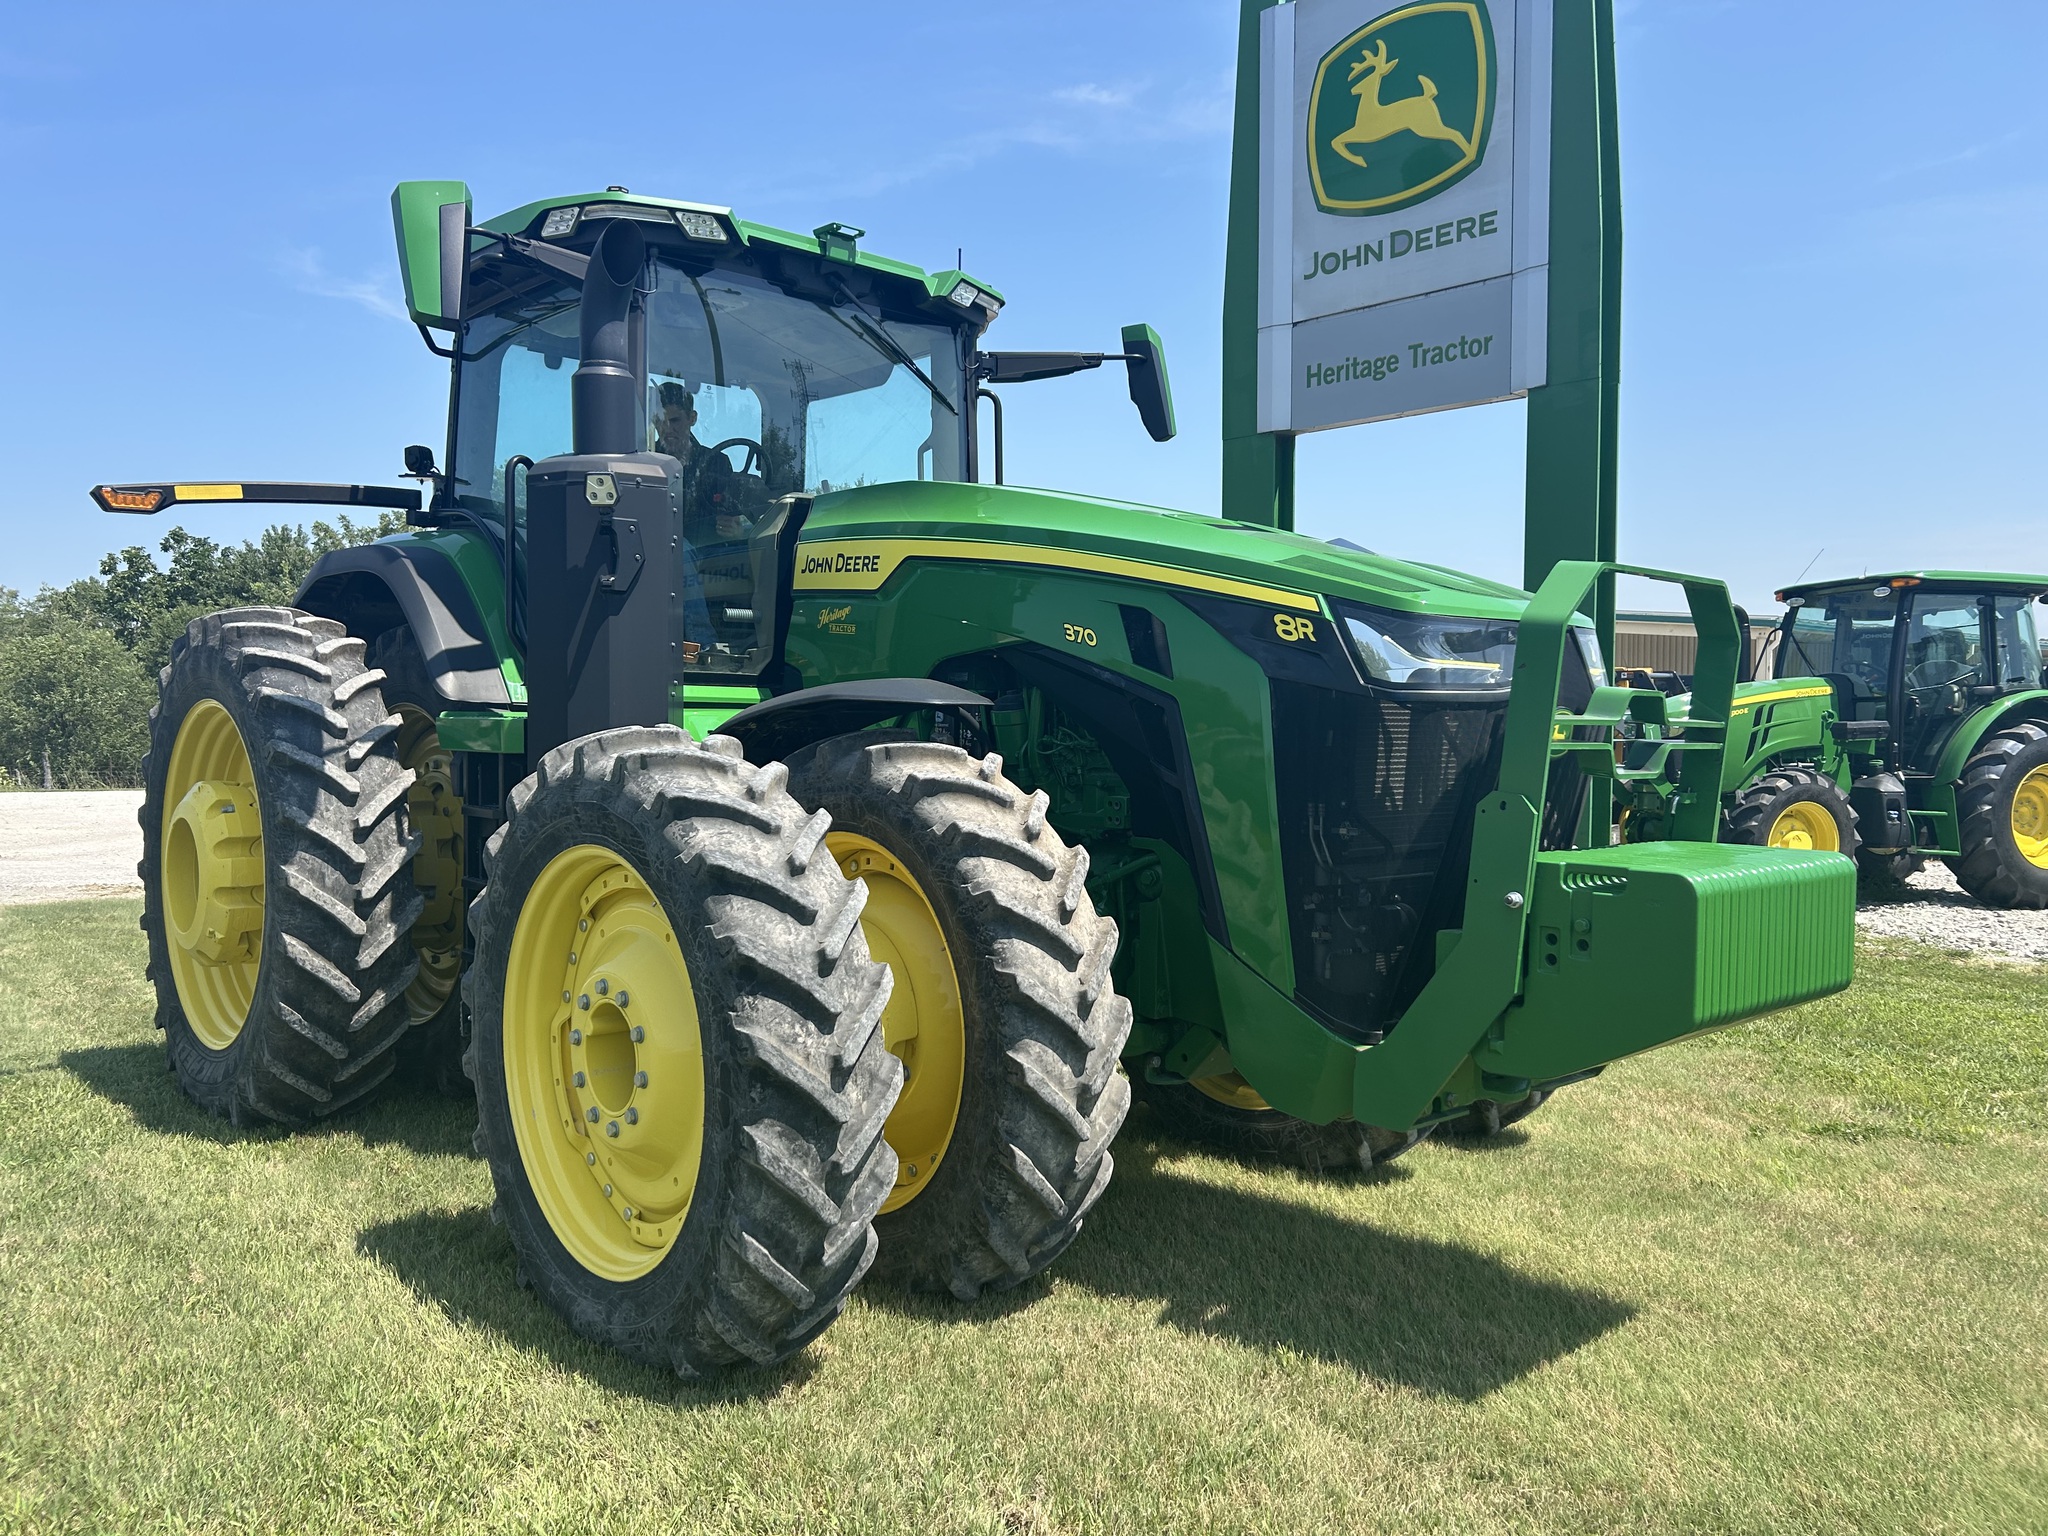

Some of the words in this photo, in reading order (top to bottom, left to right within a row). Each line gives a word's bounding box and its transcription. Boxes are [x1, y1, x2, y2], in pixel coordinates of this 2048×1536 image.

[1303, 239, 1384, 280] JOHN
[1389, 210, 1498, 259] DEERE
[1305, 353, 1400, 388] Heritage
[1407, 334, 1494, 369] Tractor
[801, 554, 834, 574] JOHN
[835, 553, 880, 573] DEERE
[817, 605, 852, 629] Heritage
[829, 624, 856, 633] TRACTOR
[1273, 613, 1317, 642] 8R
[1063, 623, 1097, 647] 370
